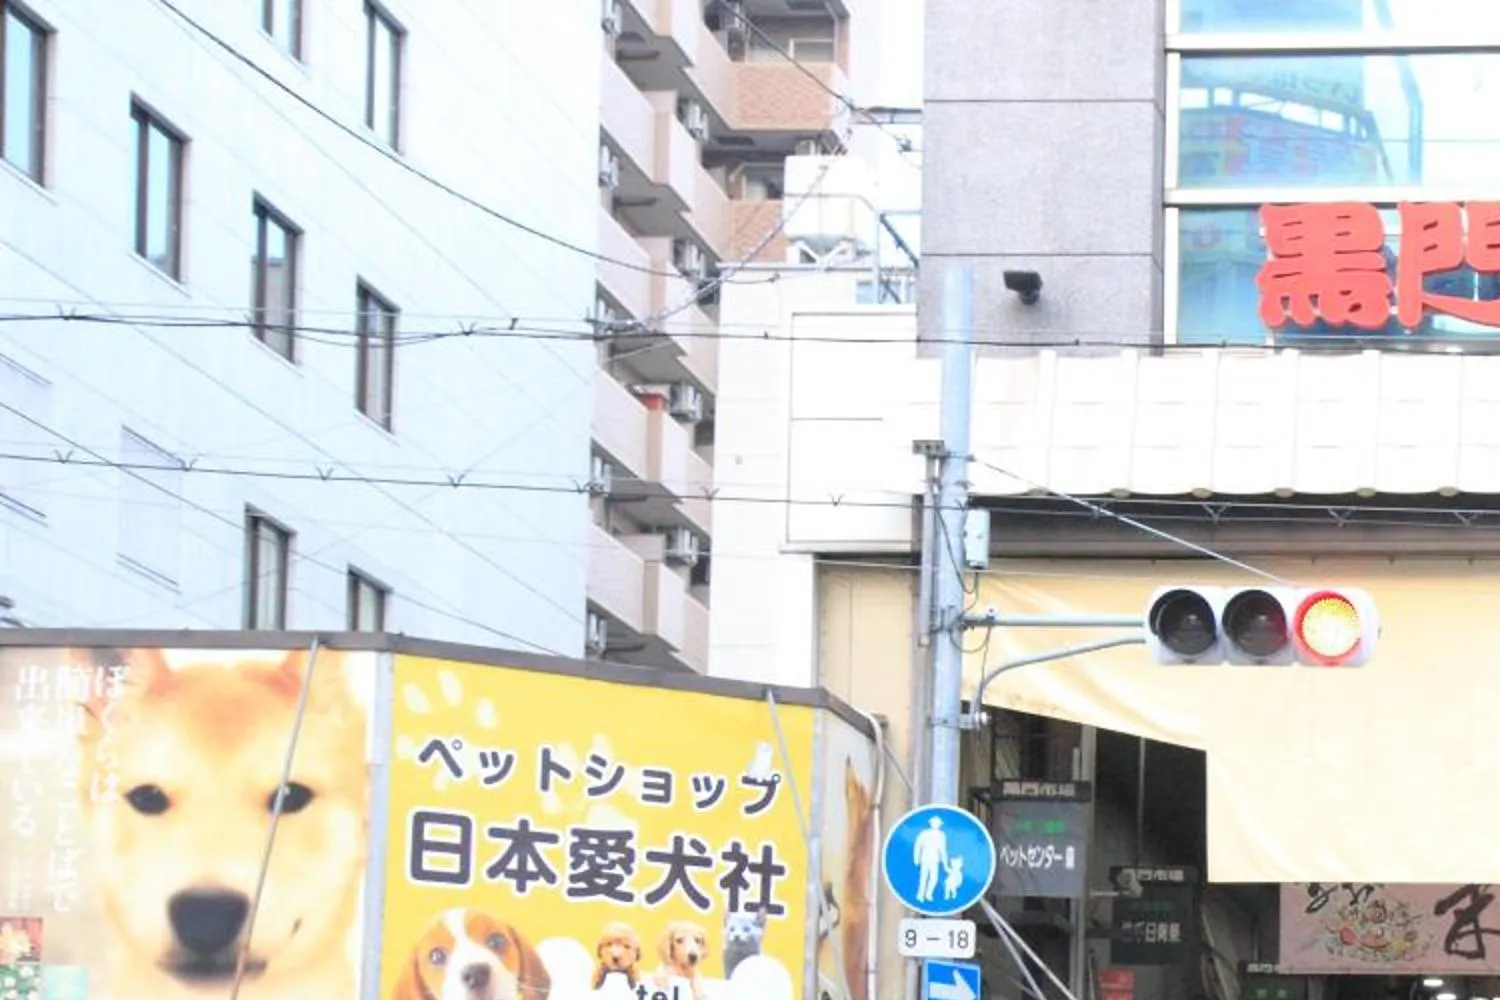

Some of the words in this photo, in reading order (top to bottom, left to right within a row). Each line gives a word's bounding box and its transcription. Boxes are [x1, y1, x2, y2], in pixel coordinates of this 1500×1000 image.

[418, 738, 782, 816] ペットショップ
[409, 810, 786, 915] 日本愛犬社
